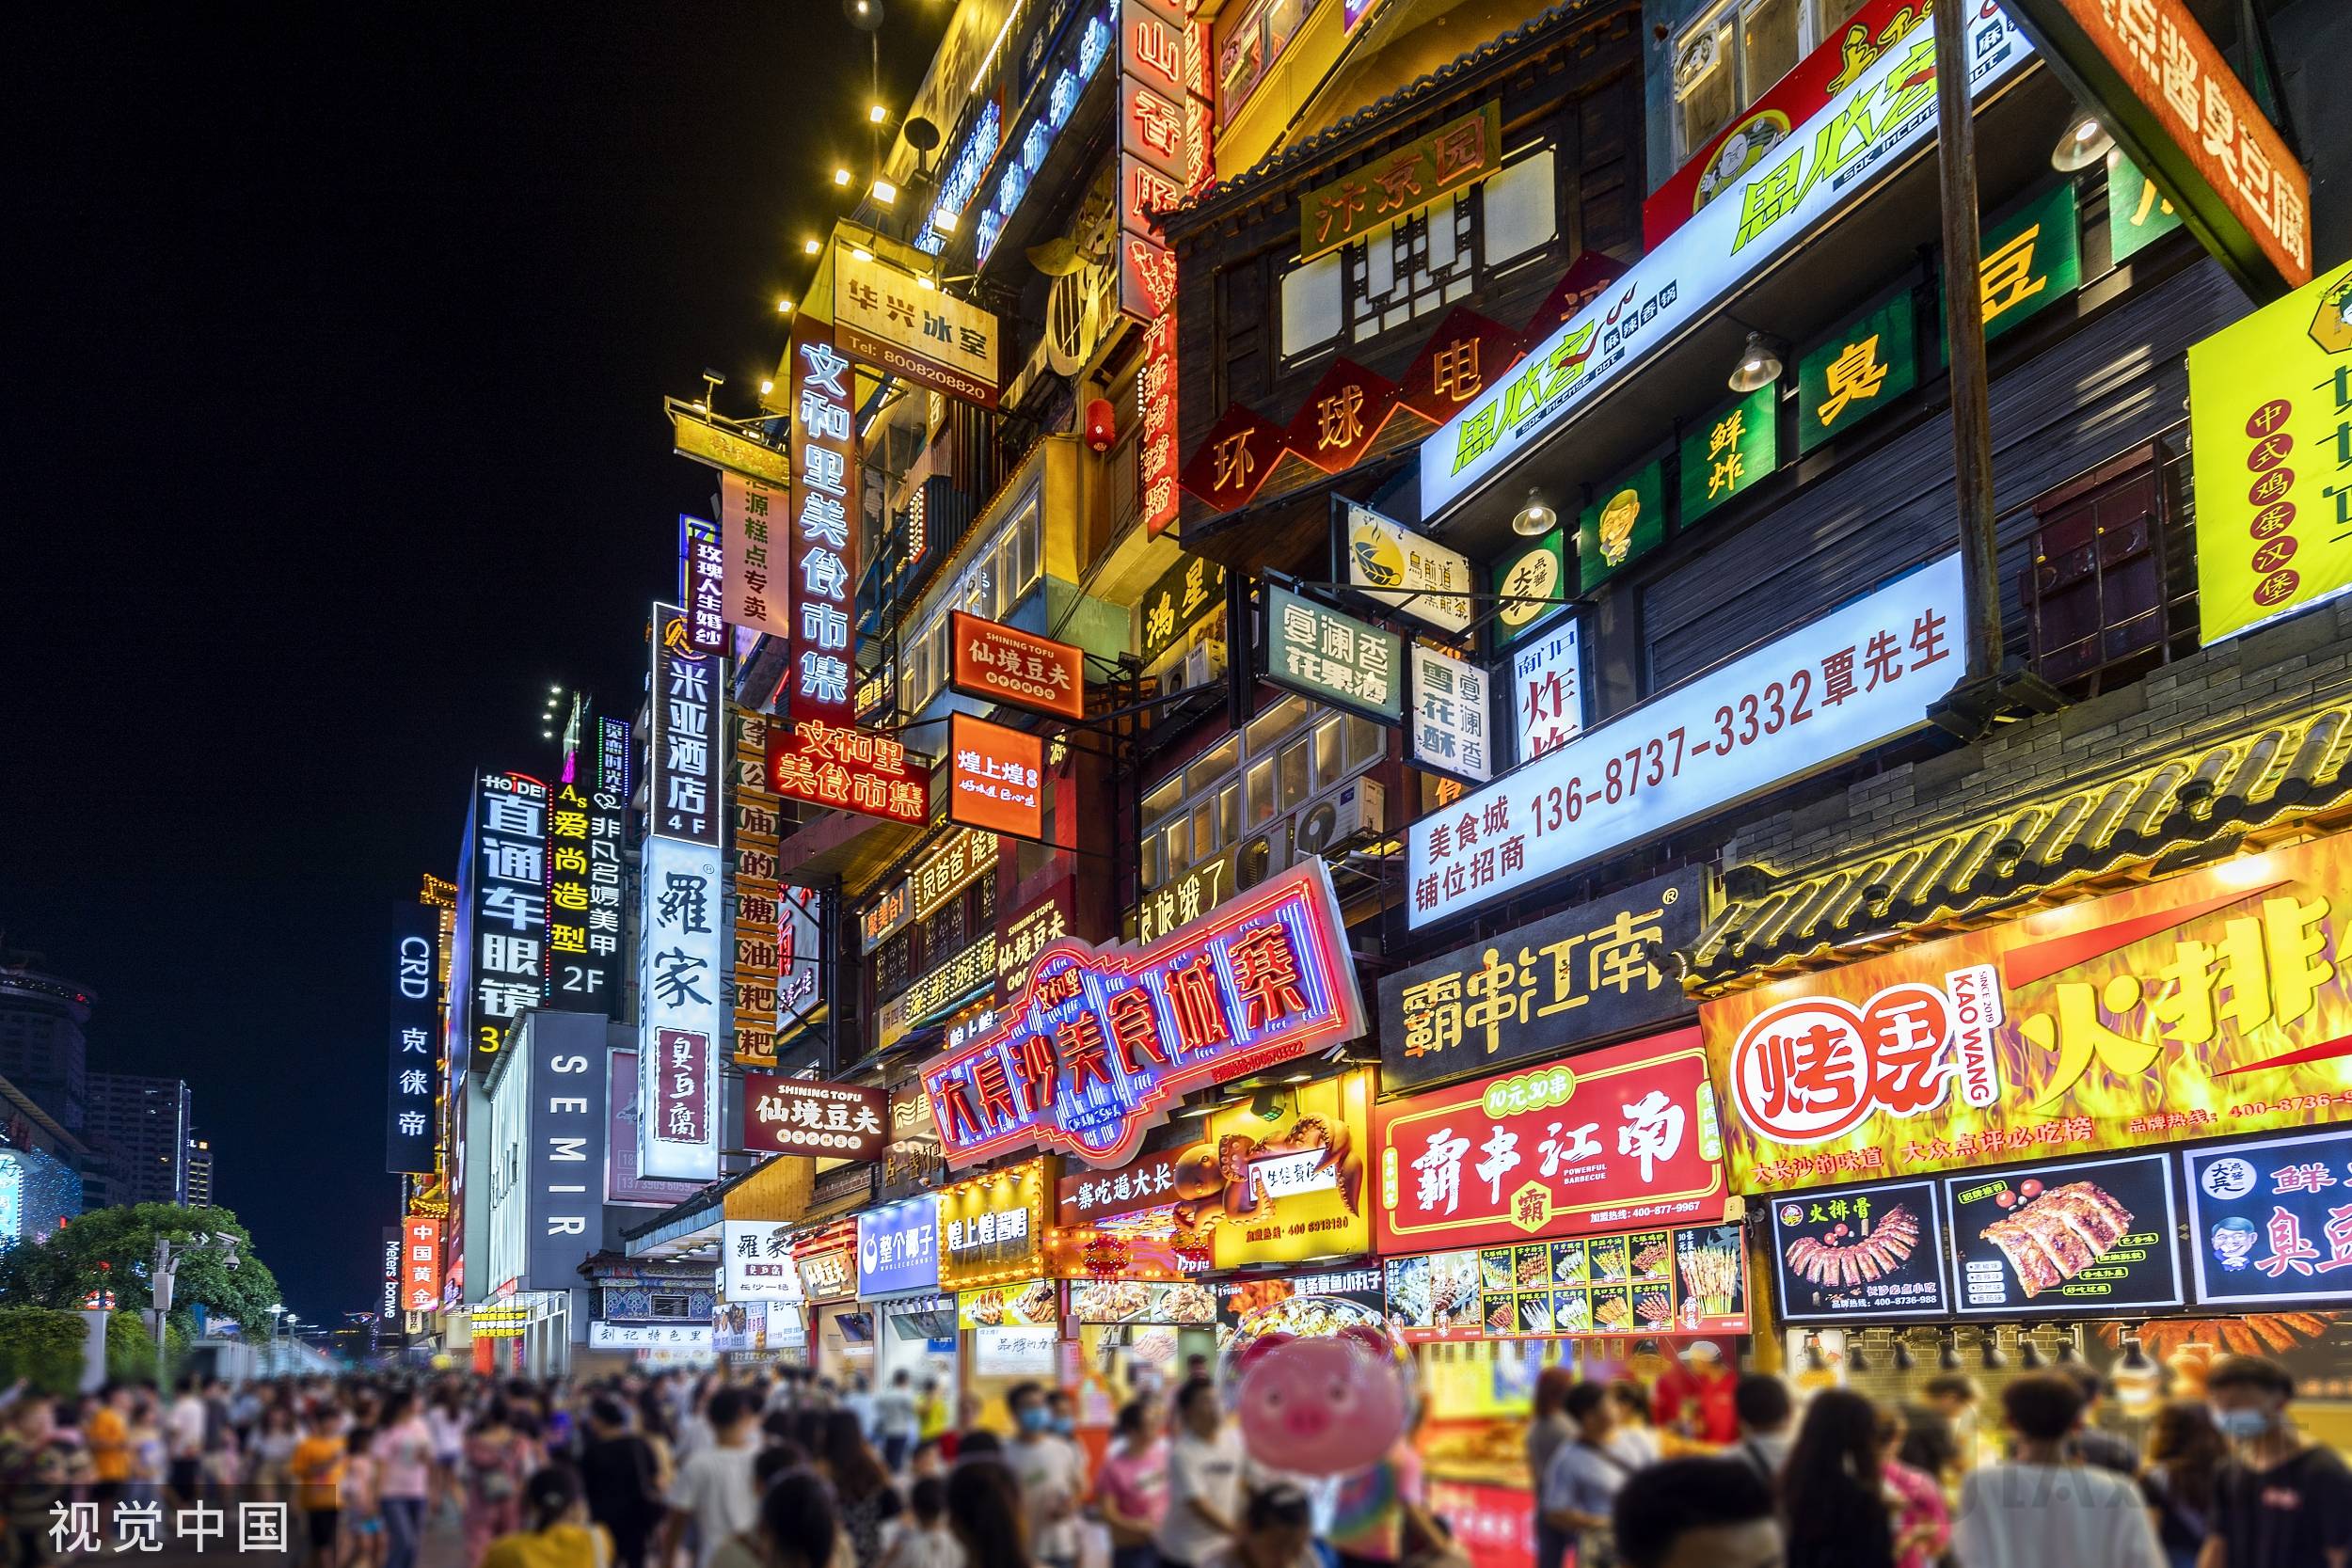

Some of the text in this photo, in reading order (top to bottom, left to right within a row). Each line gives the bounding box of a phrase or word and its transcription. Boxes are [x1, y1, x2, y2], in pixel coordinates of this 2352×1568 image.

[848, 278, 988, 359] 华兴冰室
[849, 335, 987, 402] Tel: 8008208820
[1818, 334, 1889, 427] 臭
[1707, 408, 1747, 500] 鲜炸
[800, 342, 850, 704] 文和里美食市集
[2252, 403, 2296, 604] 中式鸡蛋汉堡
[694, 543, 723, 645] 玫瑰人生婚纱
[1147, 556, 1226, 649] 鸿星
[969, 639, 1072, 690] 仙境豆夫
[986, 631, 1055, 659] SHINING TOFU
[1285, 645, 1388, 706] 花果酒
[1820, 608, 1950, 707] 覃先生
[666, 661, 709, 817] 米亚酒店
[1422, 658, 1456, 760] 雪花酥
[797, 719, 906, 775] 文和里
[957, 749, 1025, 786] 煌上煌
[1532, 670, 1814, 839] 136-8737-3332
[779, 754, 924, 818] 美食市集
[668, 815, 707, 835] 4F
[1429, 796, 1509, 864] 美食城
[478, 791, 546, 1018] 直通车眼镜
[550, 810, 589, 954] 爱尚造型
[739, 717, 773, 1057] 李公庙的糖油粑粑
[1416, 836, 1526, 913] 铺位招商
[654, 871, 713, 1009] 羅家
[998, 911, 1067, 978] 仙境豆夫
[1009, 898, 1055, 937] SHINING TOFU
[400, 937, 430, 999] CRD
[562, 965, 605, 993] 2F
[1036, 967, 1082, 1014] 文和里
[1402, 908, 1664, 1058] 霸串江南
[1979, 971, 1994, 1023] SINCE 2019
[2015, 894, 2352, 1110] 火排
[1953, 974, 1990, 1101] KAO WANG
[399, 1027, 428, 1136] 克徕帝
[755, 1096, 882, 1134] 仙境豆夫
[778, 1085, 863, 1102] SHINING TOFU
[1487, 1073, 1569, 1109] 10元30串
[548, 1054, 588, 1236] SEMIR
[1411, 1090, 1687, 1216] 霸串江南
[1563, 1164, 1608, 1176] POWERFUL
[1563, 1172, 1607, 1184] BARBECUE
[1751, 1114, 2094, 1185] 大长沙的味道 大众点评必吃榜
[1060, 1162, 1177, 1211] 一寨吃遍大长
[1518, 1190, 1548, 1225] 霸
[1808, 1196, 1871, 1224] 火排骨
[1962, 1183, 2005, 1202] 招牌推荐
[2270, 1163, 2352, 1195] 鲜
[412, 1225, 434, 1305] 中国黄金
[737, 1234, 789, 1259] 羅家
[880, 1224, 934, 1264] 整个椰子
[384, 1240, 401, 1319] Meters/bonwe
[1295, 1270, 1382, 1297] 整条章鱼小丸子
[1867, 1282, 1937, 1297] 长沙必点小吃
[600, 1328, 712, 1341] 刘记特色里
